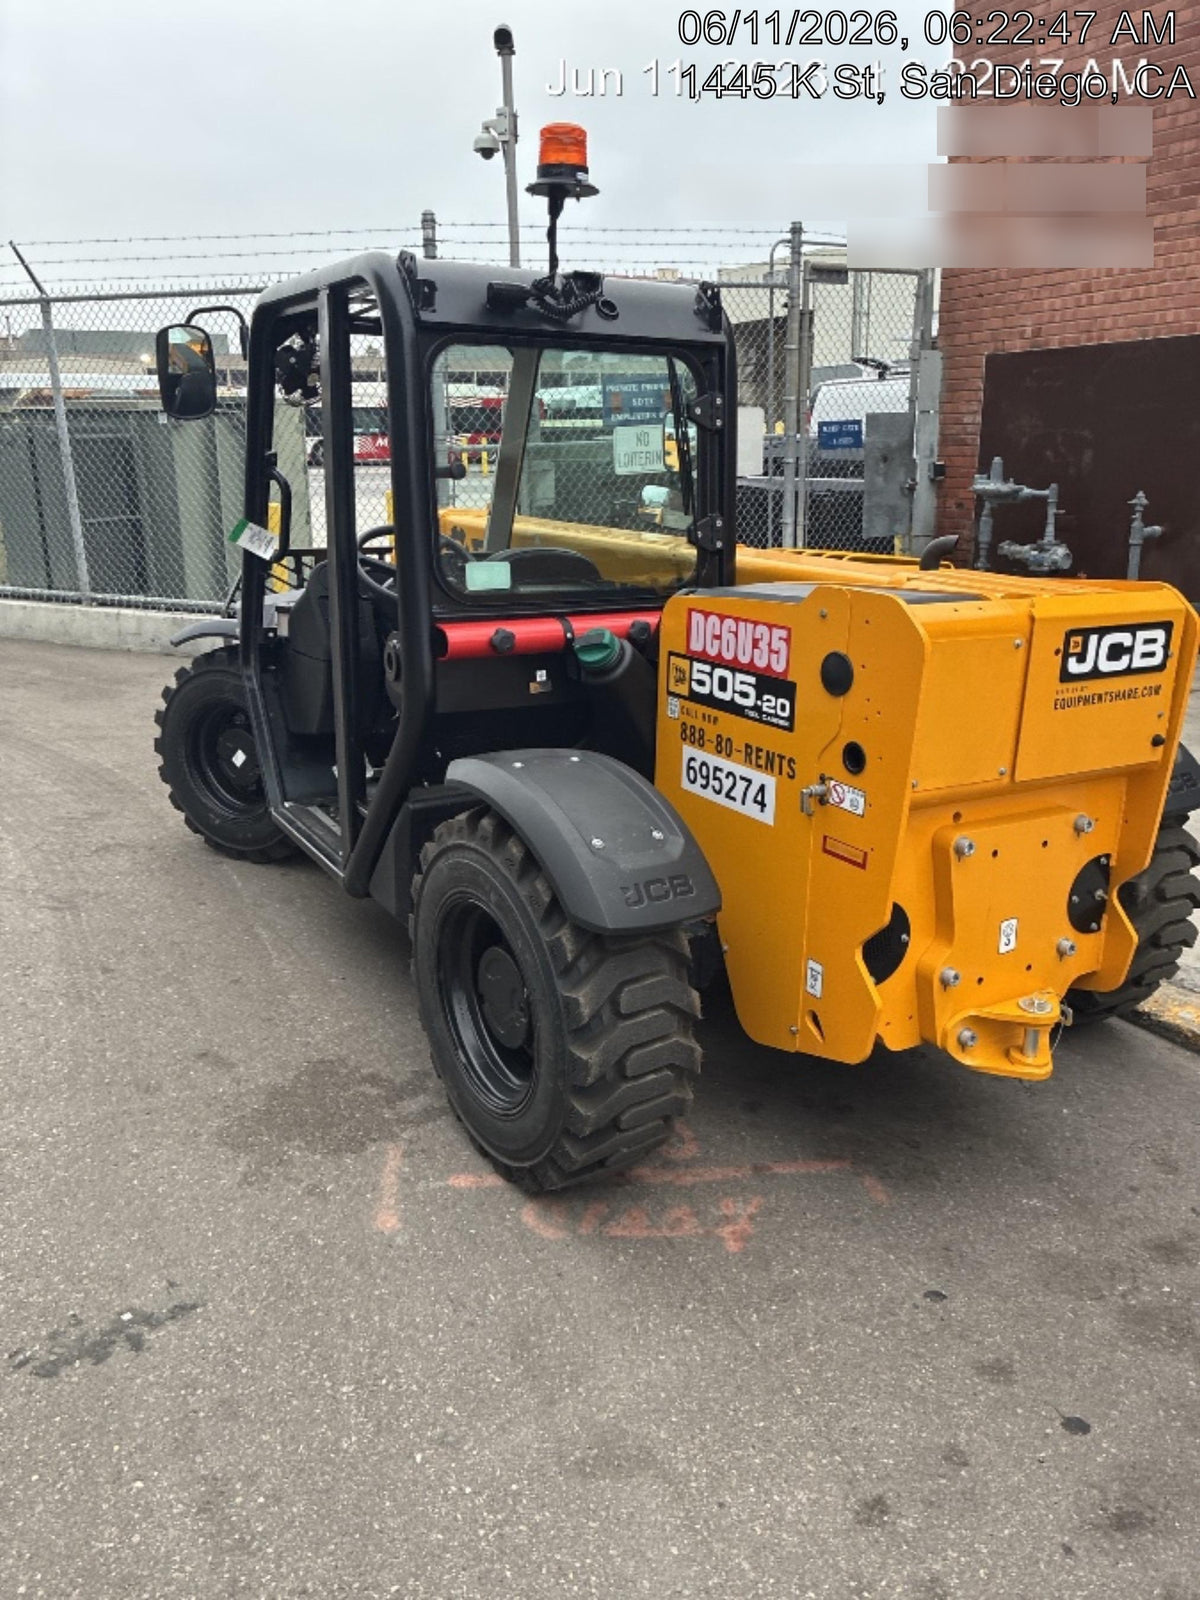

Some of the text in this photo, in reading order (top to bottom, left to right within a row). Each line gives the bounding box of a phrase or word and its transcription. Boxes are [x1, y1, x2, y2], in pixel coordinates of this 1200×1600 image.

[618, 450, 663, 468] LOITERIN
[636, 431, 650, 447] NO
[689, 611, 789, 673] DC6U35
[1066, 628, 1167, 674] JCB
[1053, 684, 1163, 711] EQUIPMENTSHARE.COM
[680, 721, 797, 781] 888-80-RENTS
[685, 756, 768, 814] 695274
[620, 874, 696, 909] JCB
